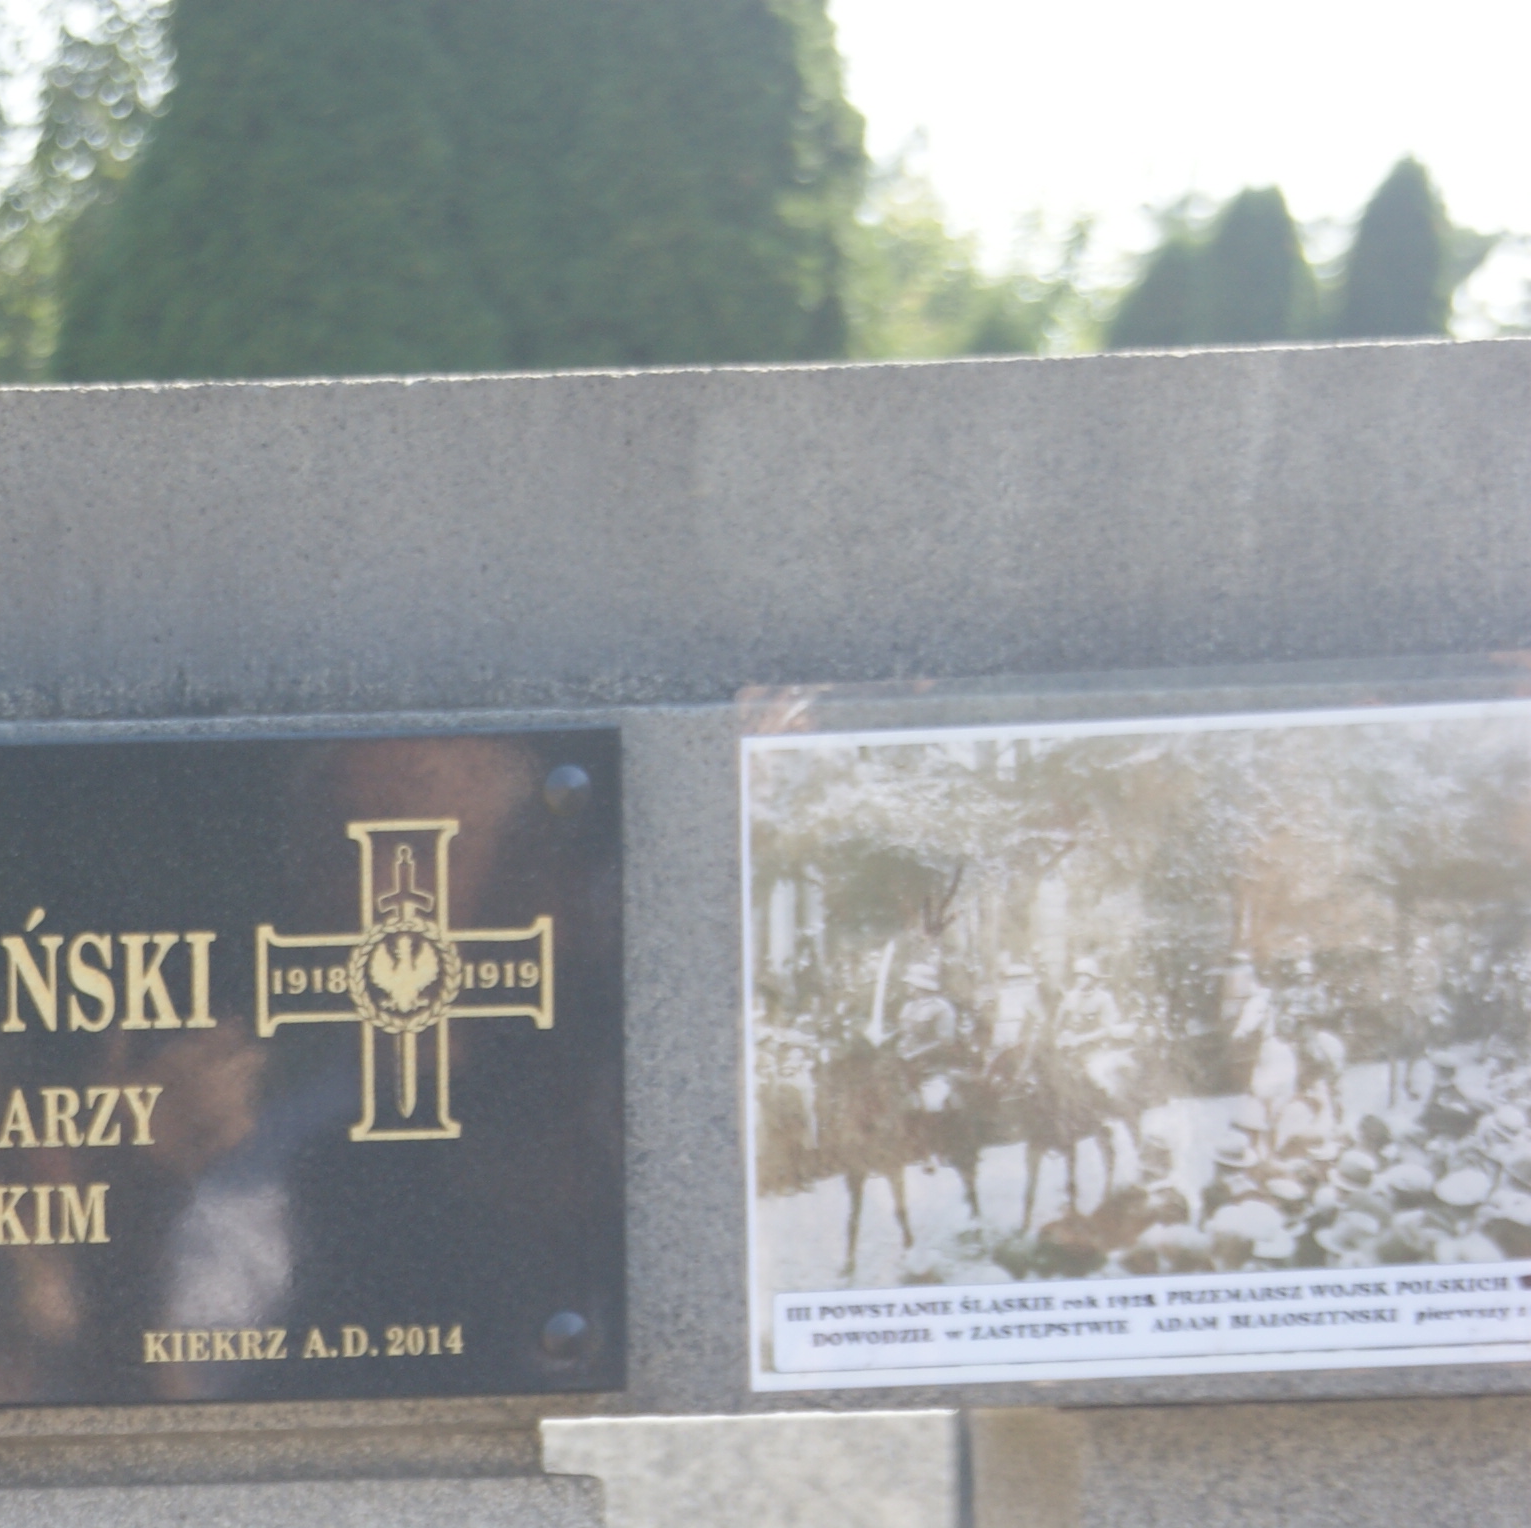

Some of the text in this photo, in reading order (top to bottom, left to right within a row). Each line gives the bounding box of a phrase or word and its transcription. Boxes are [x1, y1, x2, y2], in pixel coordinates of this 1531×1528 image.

[270, 966, 349, 994] 1918
[463, 960, 540, 989] 1919
[818, 1301, 953, 1321] POWSTANIE
[1166, 1283, 1302, 1304] PRZEMARSZ
[1308, 1280, 1387, 1299] WOJSK
[1395, 1276, 1509, 1295] POLSKICH
[1151, 1314, 1219, 1333] ADAM
[143, 1325, 462, 1363] KIEKRZ A.D. 2014
